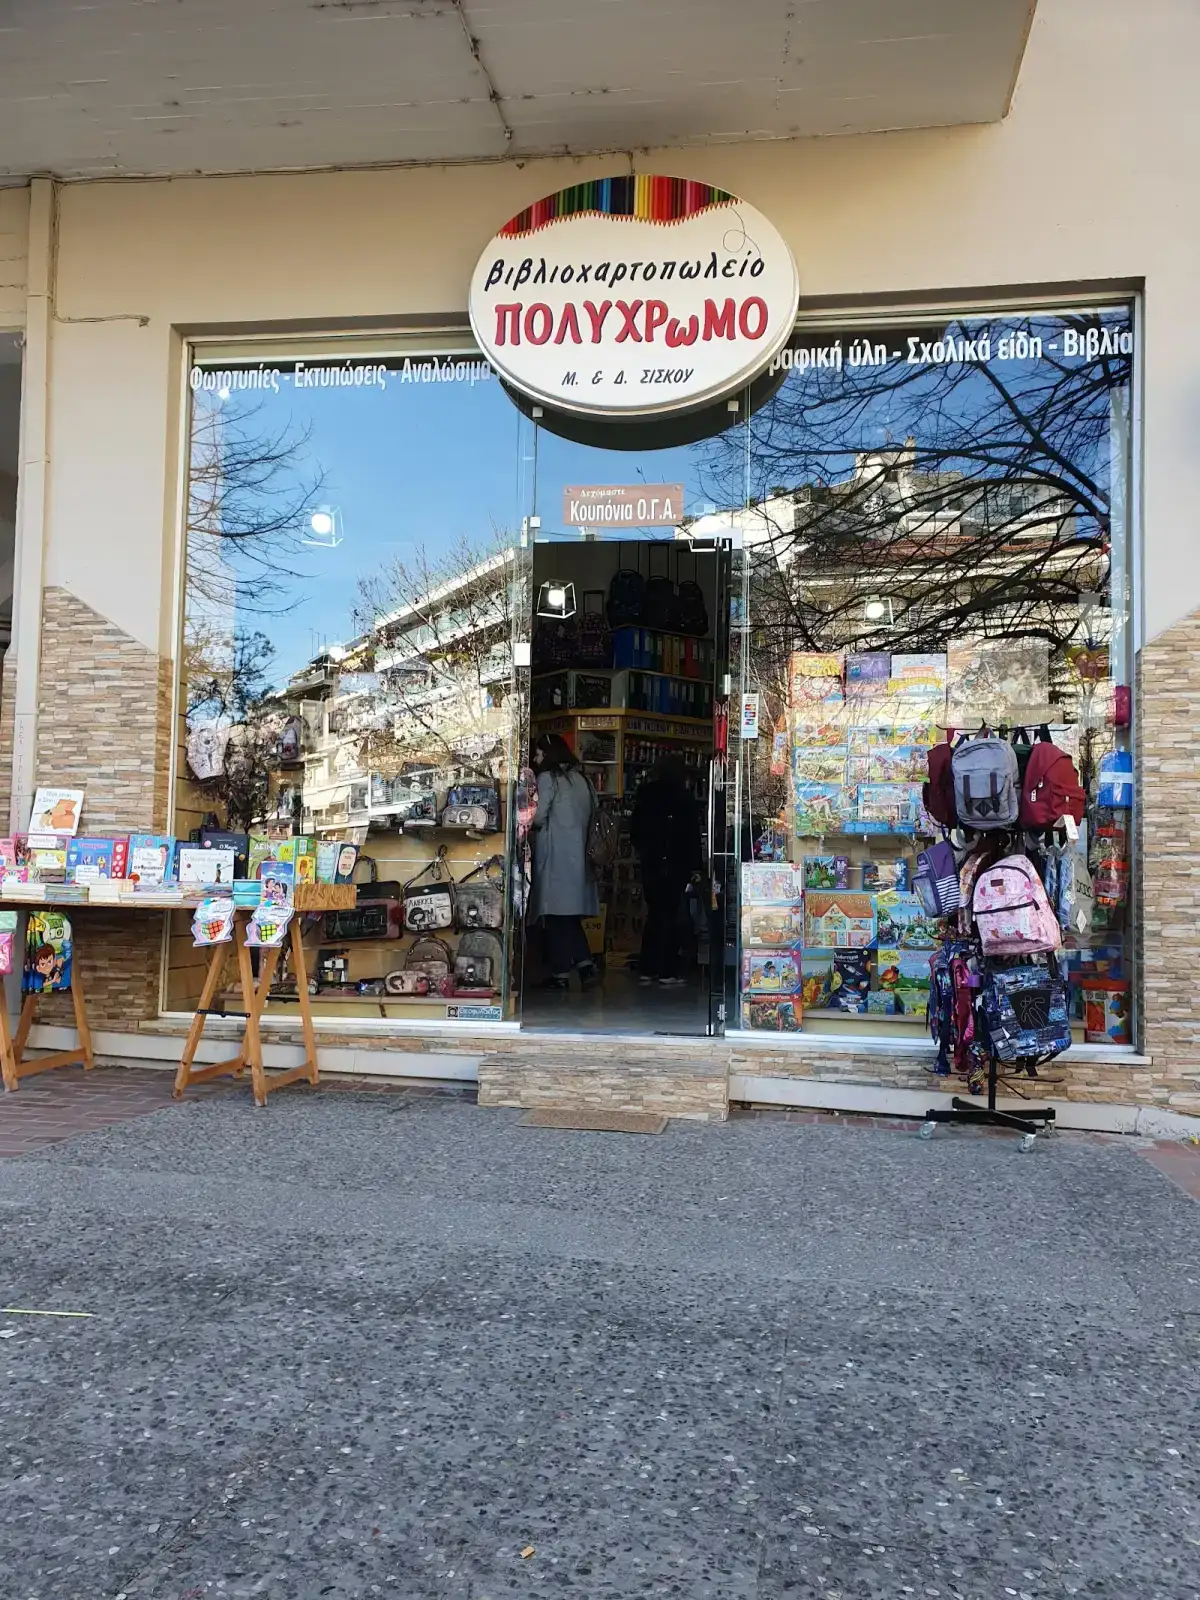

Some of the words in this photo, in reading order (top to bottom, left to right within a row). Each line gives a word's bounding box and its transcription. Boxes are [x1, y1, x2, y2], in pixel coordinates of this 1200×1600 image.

[484, 250, 765, 291] βιβλιοχαρτοπωλείο
[769, 340, 842, 376] ραφική
[848, 338, 887, 370] ύλη
[907, 328, 991, 365] Σχολικά
[998, 328, 1043, 363] είδη
[1063, 326, 1133, 362] Βιβλία
[190, 363, 280, 394] Φωτοτυπίες
[294, 359, 387, 391] Εκτυπώσεις
[400, 355, 491, 387] Αναλώσιμα
[562, 370, 579, 386] Μ.
[592, 370, 604, 385] &
[613, 370, 628, 385] Δ.
[639, 368, 694, 384] ΣΙΣΚΟΥ
[580, 488, 626, 499] Δεχόμαστε
[570, 499, 633, 522] Κουπόνια
[637, 498, 677, 520] Ο.Γ.Α.
[49, 927, 64, 940] 10
